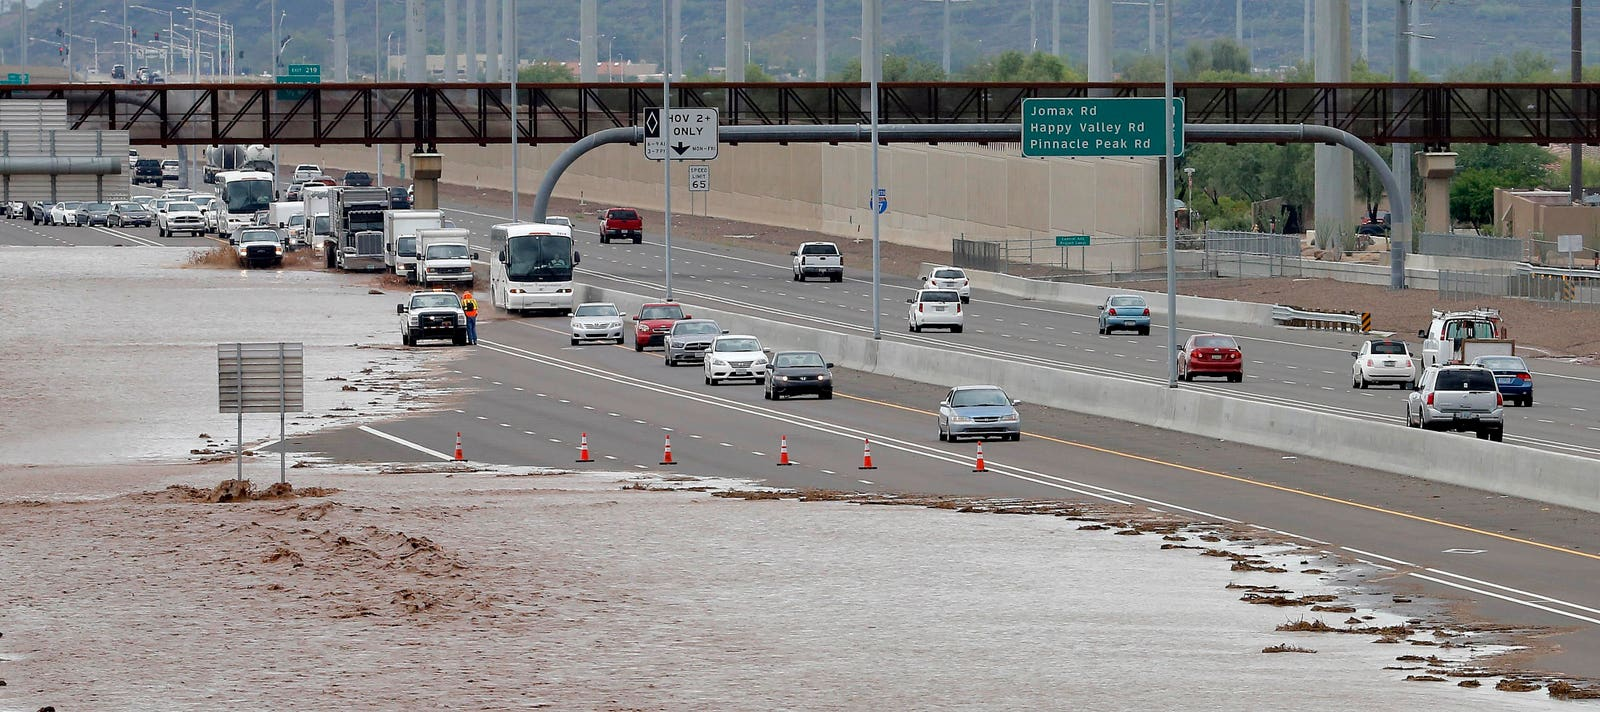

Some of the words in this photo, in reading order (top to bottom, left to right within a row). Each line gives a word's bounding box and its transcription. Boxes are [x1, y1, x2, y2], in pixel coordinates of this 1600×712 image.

[1031, 106, 1074, 116] Jomax
[1081, 105, 1097, 116] Rd
[697, 114, 711, 123] 2+
[673, 127, 704, 136] ONLY
[1030, 122, 1072, 134] Happy
[1079, 122, 1121, 134] Valley
[1128, 122, 1145, 132] Rd
[1030, 138, 1089, 149] Pinnacle
[1096, 138, 1128, 149] Peak
[1134, 138, 1151, 149] Rd
[692, 181, 706, 189] 65
